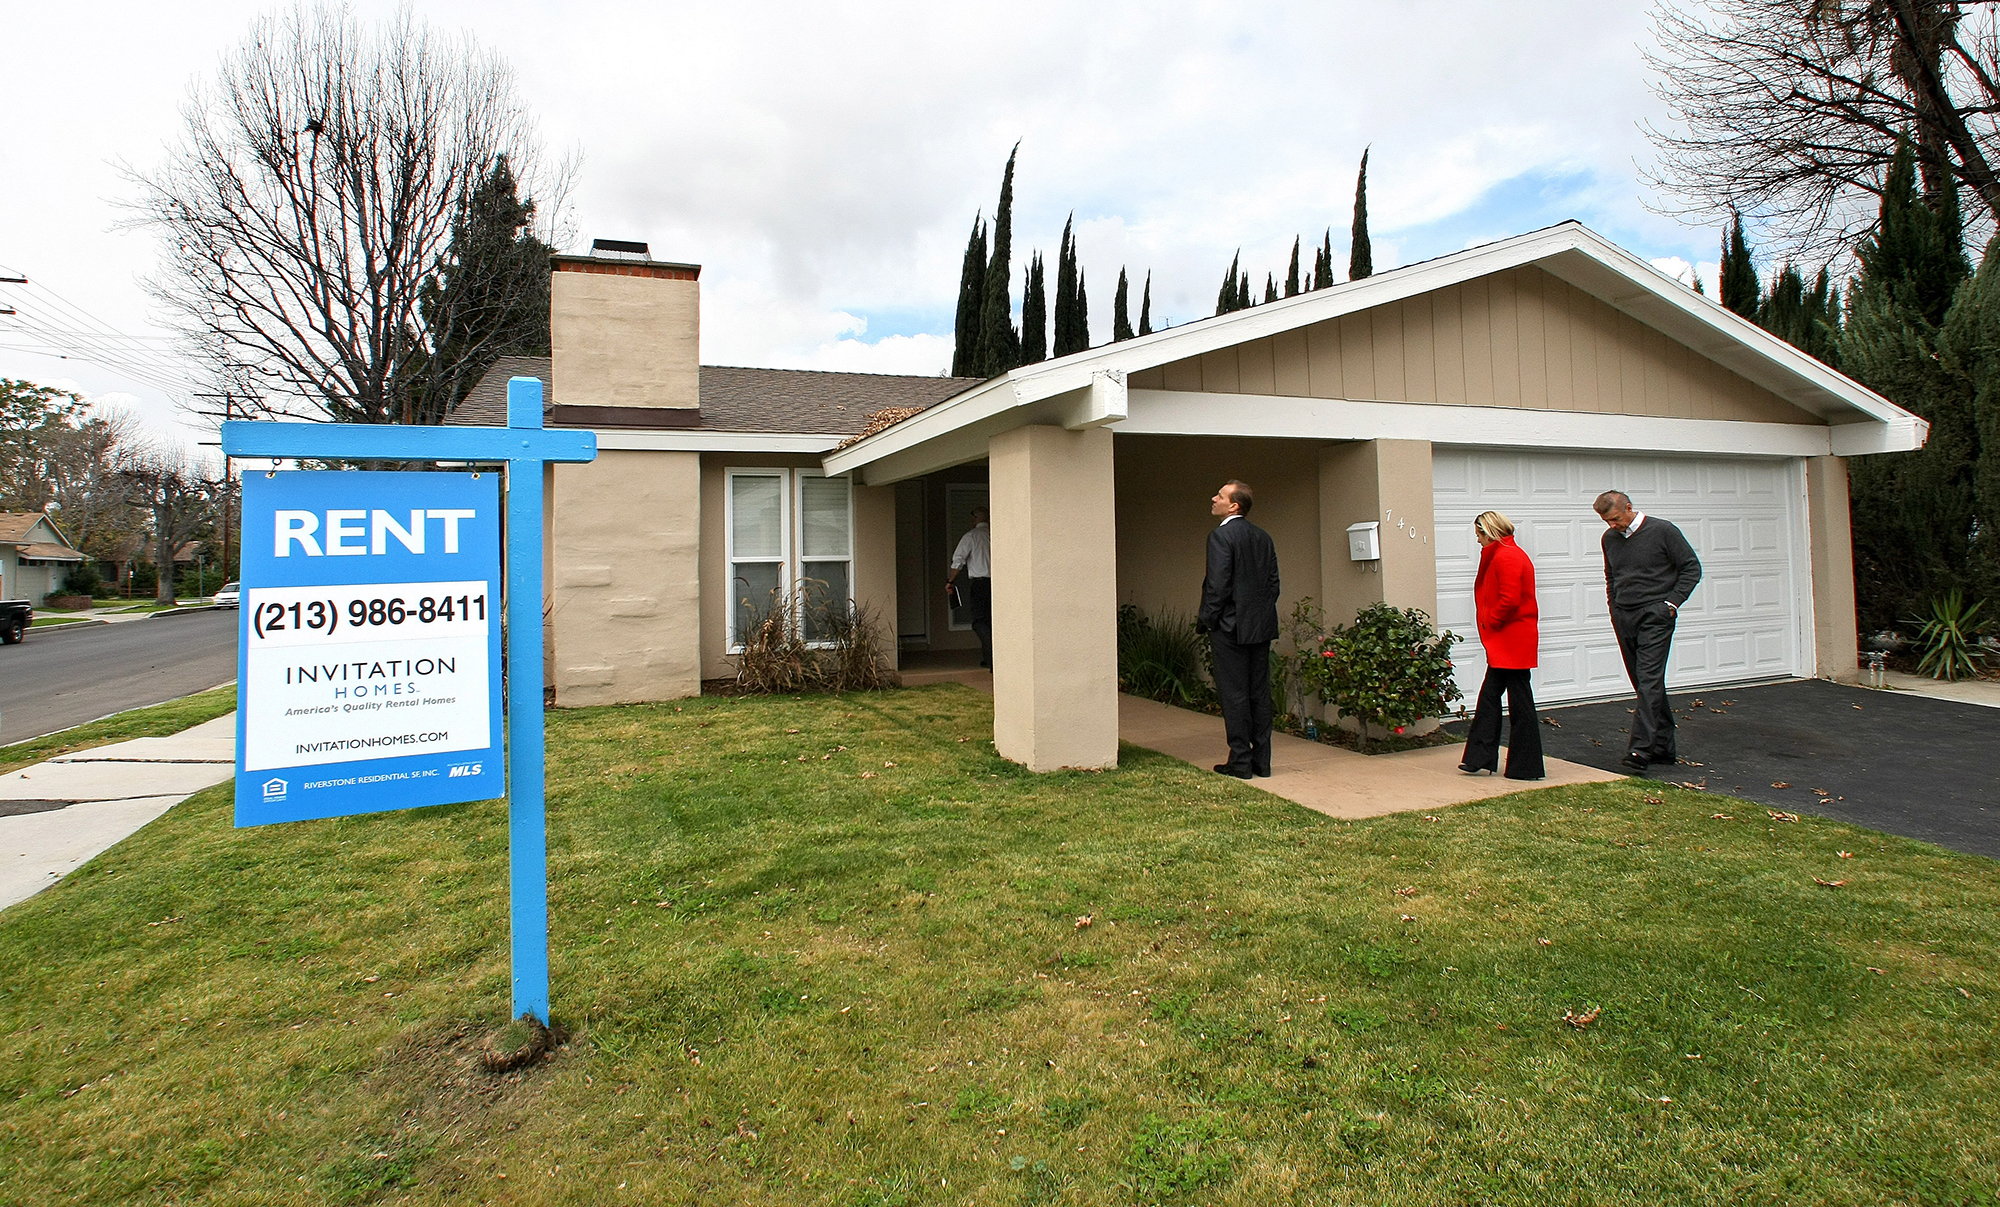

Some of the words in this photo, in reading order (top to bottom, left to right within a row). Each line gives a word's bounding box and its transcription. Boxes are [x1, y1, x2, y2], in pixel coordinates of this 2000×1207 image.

[274, 509, 476, 558] RENT
[254, 601, 338, 639] (213)
[349, 594, 486, 627] 986-8411
[286, 657, 456, 684] INVITATION
[335, 682, 416, 699] HOMES
[284, 705, 339, 717] America's
[343, 702, 383, 713] Quality
[385, 698, 420, 708] Rental
[422, 697, 457, 706] Homes
[296, 731, 448, 754] INVITATIONHOMES.COM
[303, 777, 357, 790] RIVERSTONE
[358, 772, 410, 785] RESIDENTIAL
[422, 769, 440, 777] INC.
[448, 764, 483, 778] MLS
